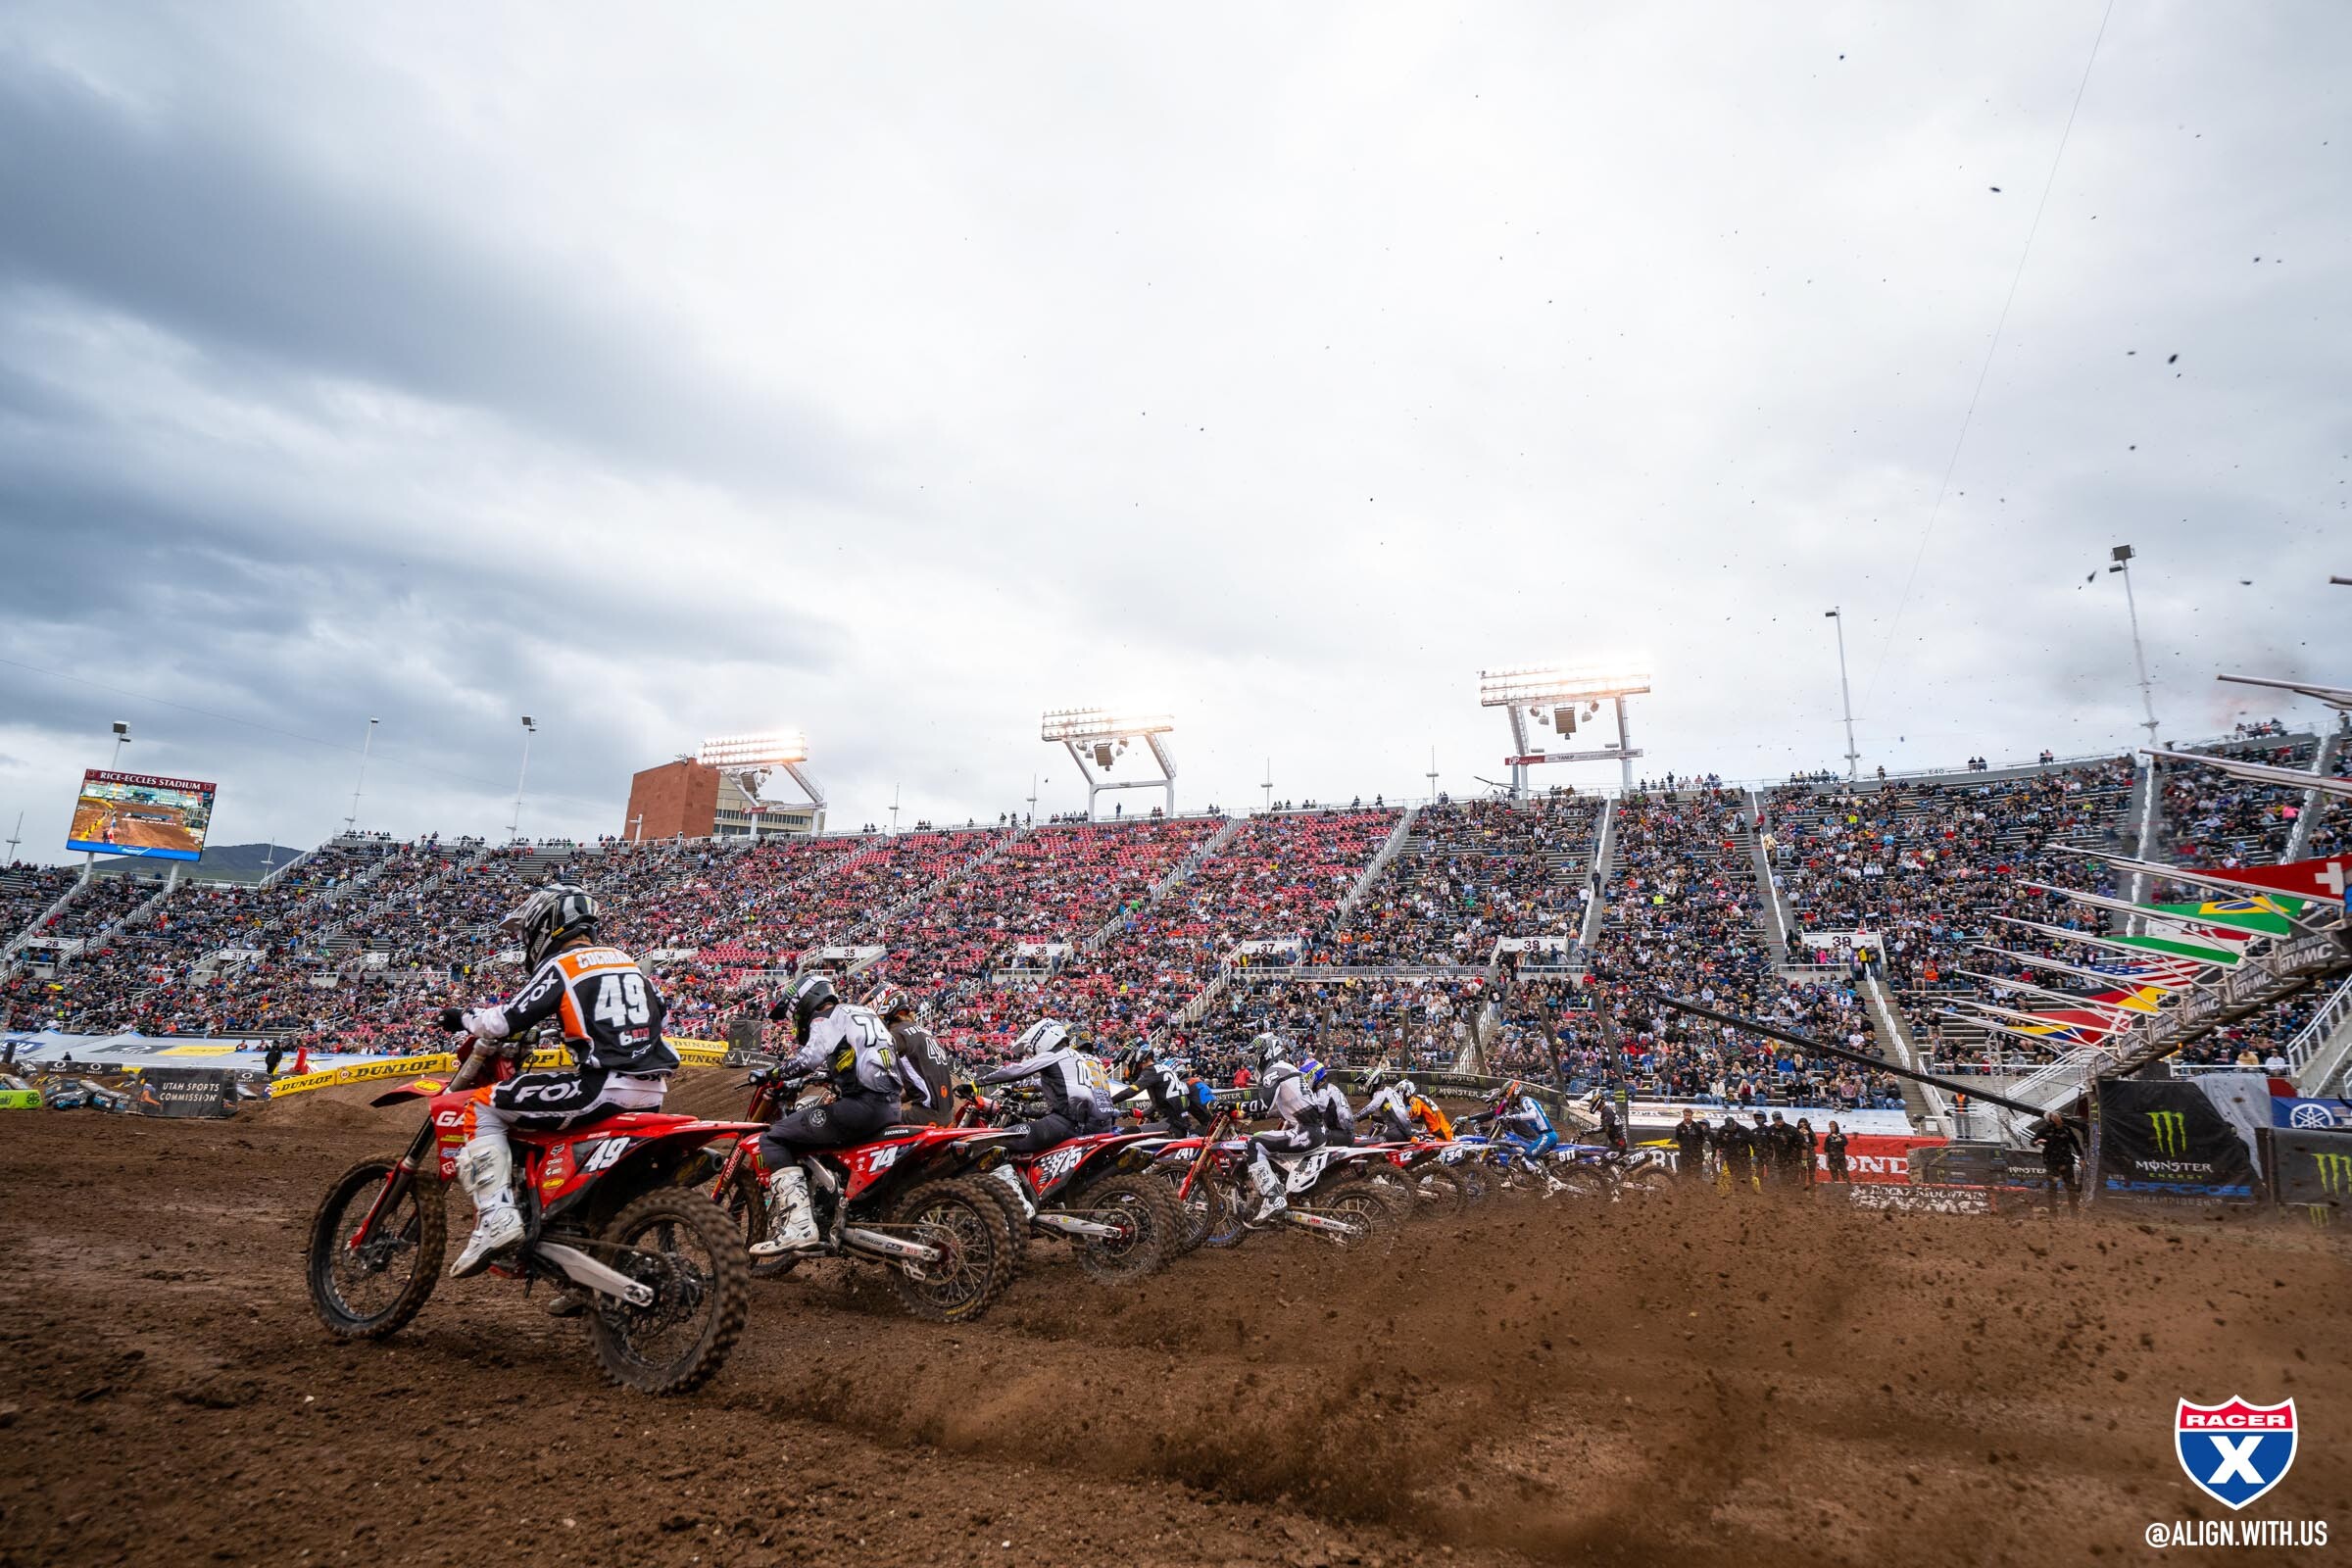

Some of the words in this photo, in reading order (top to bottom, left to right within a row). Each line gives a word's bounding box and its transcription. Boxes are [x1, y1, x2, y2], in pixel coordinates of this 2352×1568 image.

[100, 771, 157, 784] RICE-ECCLES
[159, 778, 200, 790] STADIUM
[843, 949, 856, 957] 35
[1035, 946, 1048, 955] 36
[517, 970, 560, 1013] FOX
[594, 972, 651, 1028] 49
[354, 1059, 438, 1079] DUNLOP
[163, 1081, 184, 1091] UTAH
[186, 1082, 220, 1092] SPORTS
[280, 1074, 333, 1092] DUNLOP
[514, 1079, 583, 1103] FOX
[159, 1093, 218, 1102] COMMISSION
[1439, 1087, 1480, 1098] MONSTER
[585, 1137, 631, 1172] 49
[868, 1146, 900, 1173] 74
[2134, 1159, 2215, 1174] MONSTER
